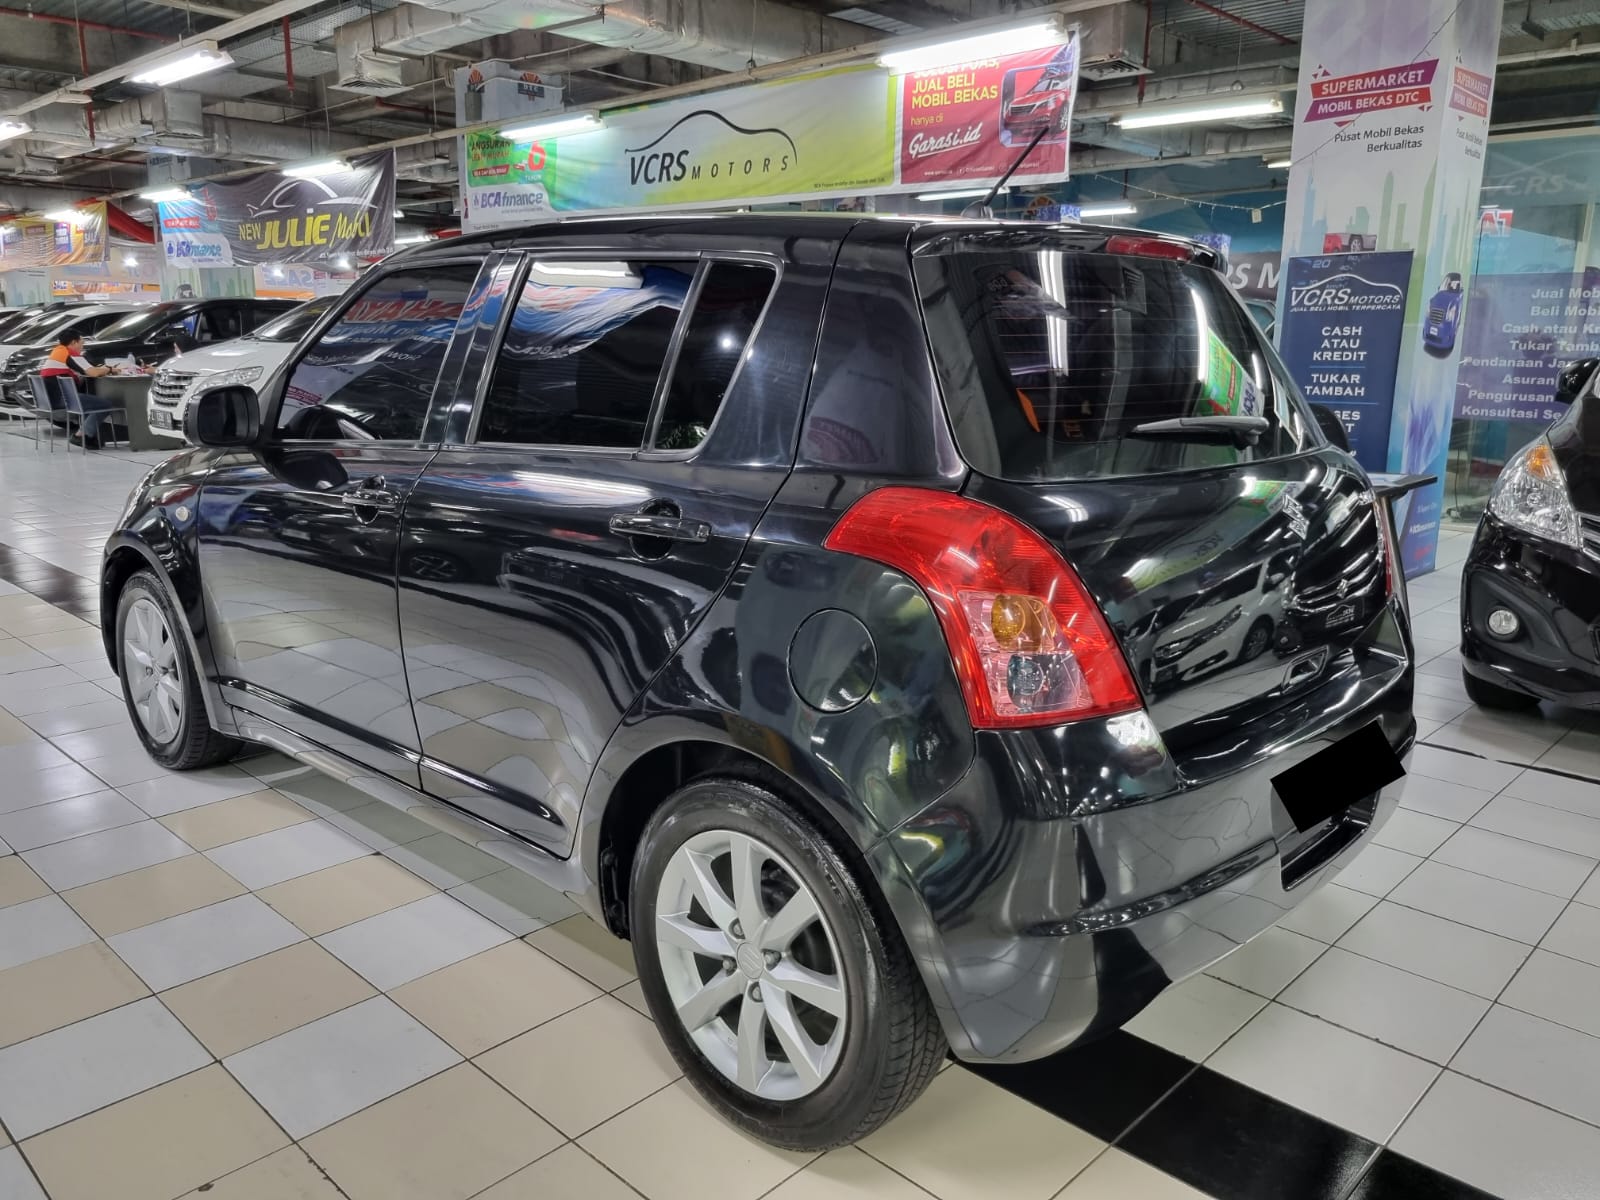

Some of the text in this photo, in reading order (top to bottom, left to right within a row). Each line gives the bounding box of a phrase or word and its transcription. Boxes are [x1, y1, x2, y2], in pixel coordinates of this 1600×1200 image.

[912, 77, 944, 94] JUAL
[947, 72, 976, 90] BELI
[1321, 70, 1425, 96] SUPERMARKET
[911, 85, 999, 109] MOBIL BEKAS
[1317, 91, 1420, 115] MOBIL BEKAS DTC
[910, 114, 944, 127] hanya di
[1334, 124, 1425, 143] Pusat Mobil Bekas
[908, 122, 984, 160] Garasi.id
[1366, 138, 1423, 153] Berkualitas
[527, 140, 547, 172] 6
[630, 149, 789, 186] VCRS MOTORS
[238, 222, 262, 241] NEW
[1290, 288, 1401, 306] VCRS MOTORS
[1531, 288, 1564, 299] Jual
[1530, 305, 1559, 316] Beli
[1321, 326, 1363, 336] CASH
[1501, 323, 1539, 334] Cash
[1543, 323, 1578, 334] atau
[1321, 338, 1360, 349] ATAU
[1509, 340, 1553, 351] Tukar
[1312, 351, 1368, 361] KREDIT
[1463, 357, 1544, 368] Pendanaan
[1310, 373, 1361, 384] TUKAR
[1304, 385, 1366, 396] TAMBAH
[1467, 389, 1555, 403] Pengurusan
[1461, 405, 1539, 419] Konsultasi
